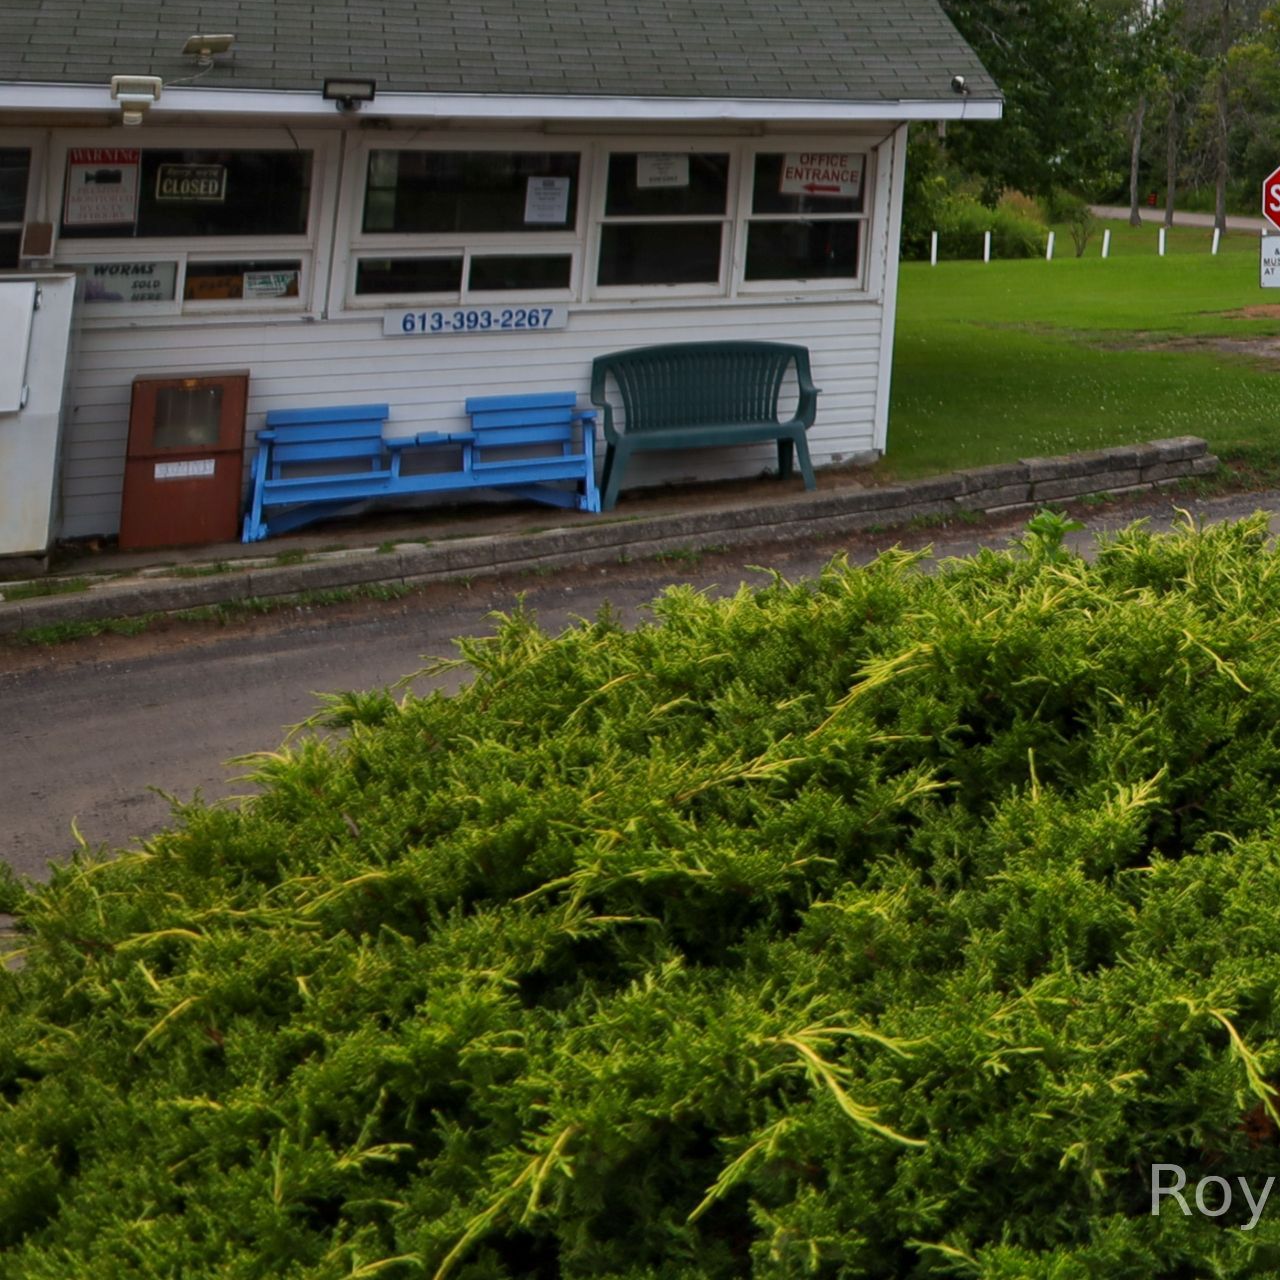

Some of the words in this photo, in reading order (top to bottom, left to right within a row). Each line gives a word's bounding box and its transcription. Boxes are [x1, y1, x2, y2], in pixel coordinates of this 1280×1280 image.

[71, 148, 138, 161] WARNING
[799, 152, 849, 168] OFFICE
[784, 166, 859, 184] ENTRANCE
[162, 178, 219, 195] CLOSED
[1274, 248, 1280, 256] &
[93, 263, 157, 276] WORMS
[1264, 267, 1275, 276] AT
[131, 280, 161, 289] SOLD
[402, 308, 553, 332] 613-393-2267
